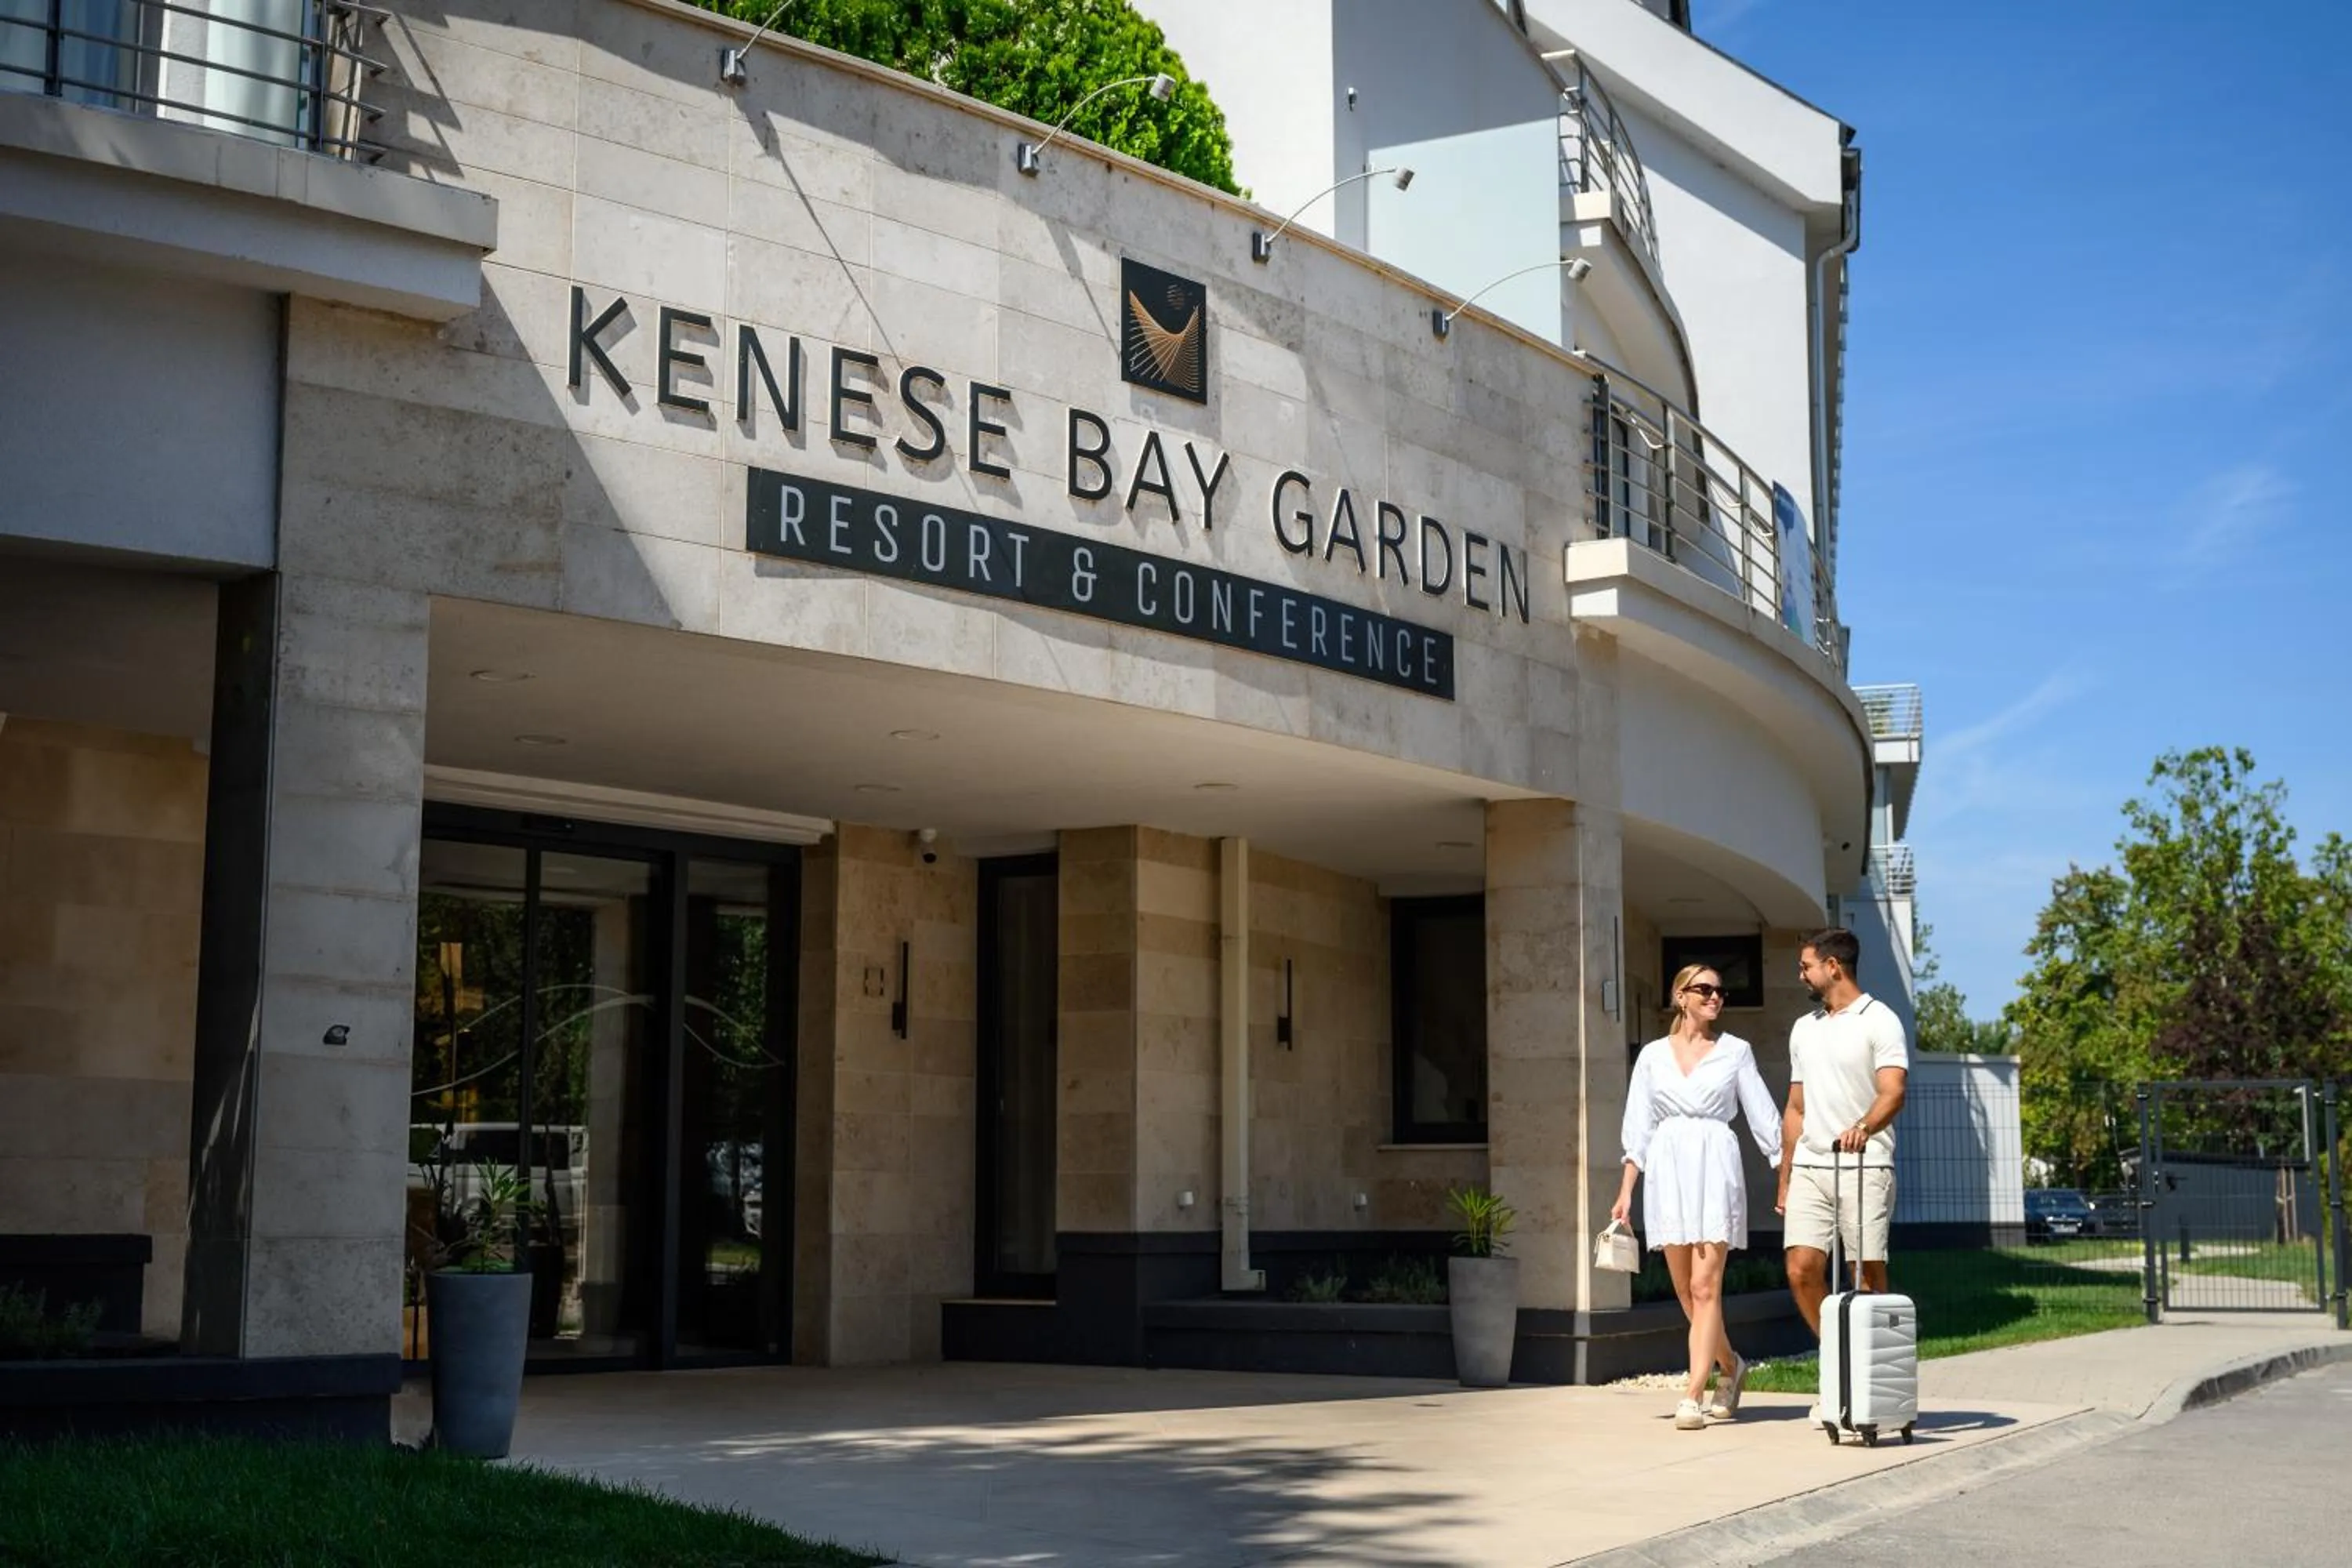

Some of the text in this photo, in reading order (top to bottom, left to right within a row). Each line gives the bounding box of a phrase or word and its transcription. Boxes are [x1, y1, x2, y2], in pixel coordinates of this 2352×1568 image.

[568, 285, 1530, 625] KENESE BAY GARDEN
[779, 485, 1437, 684] RESORT & CONFERENCE
